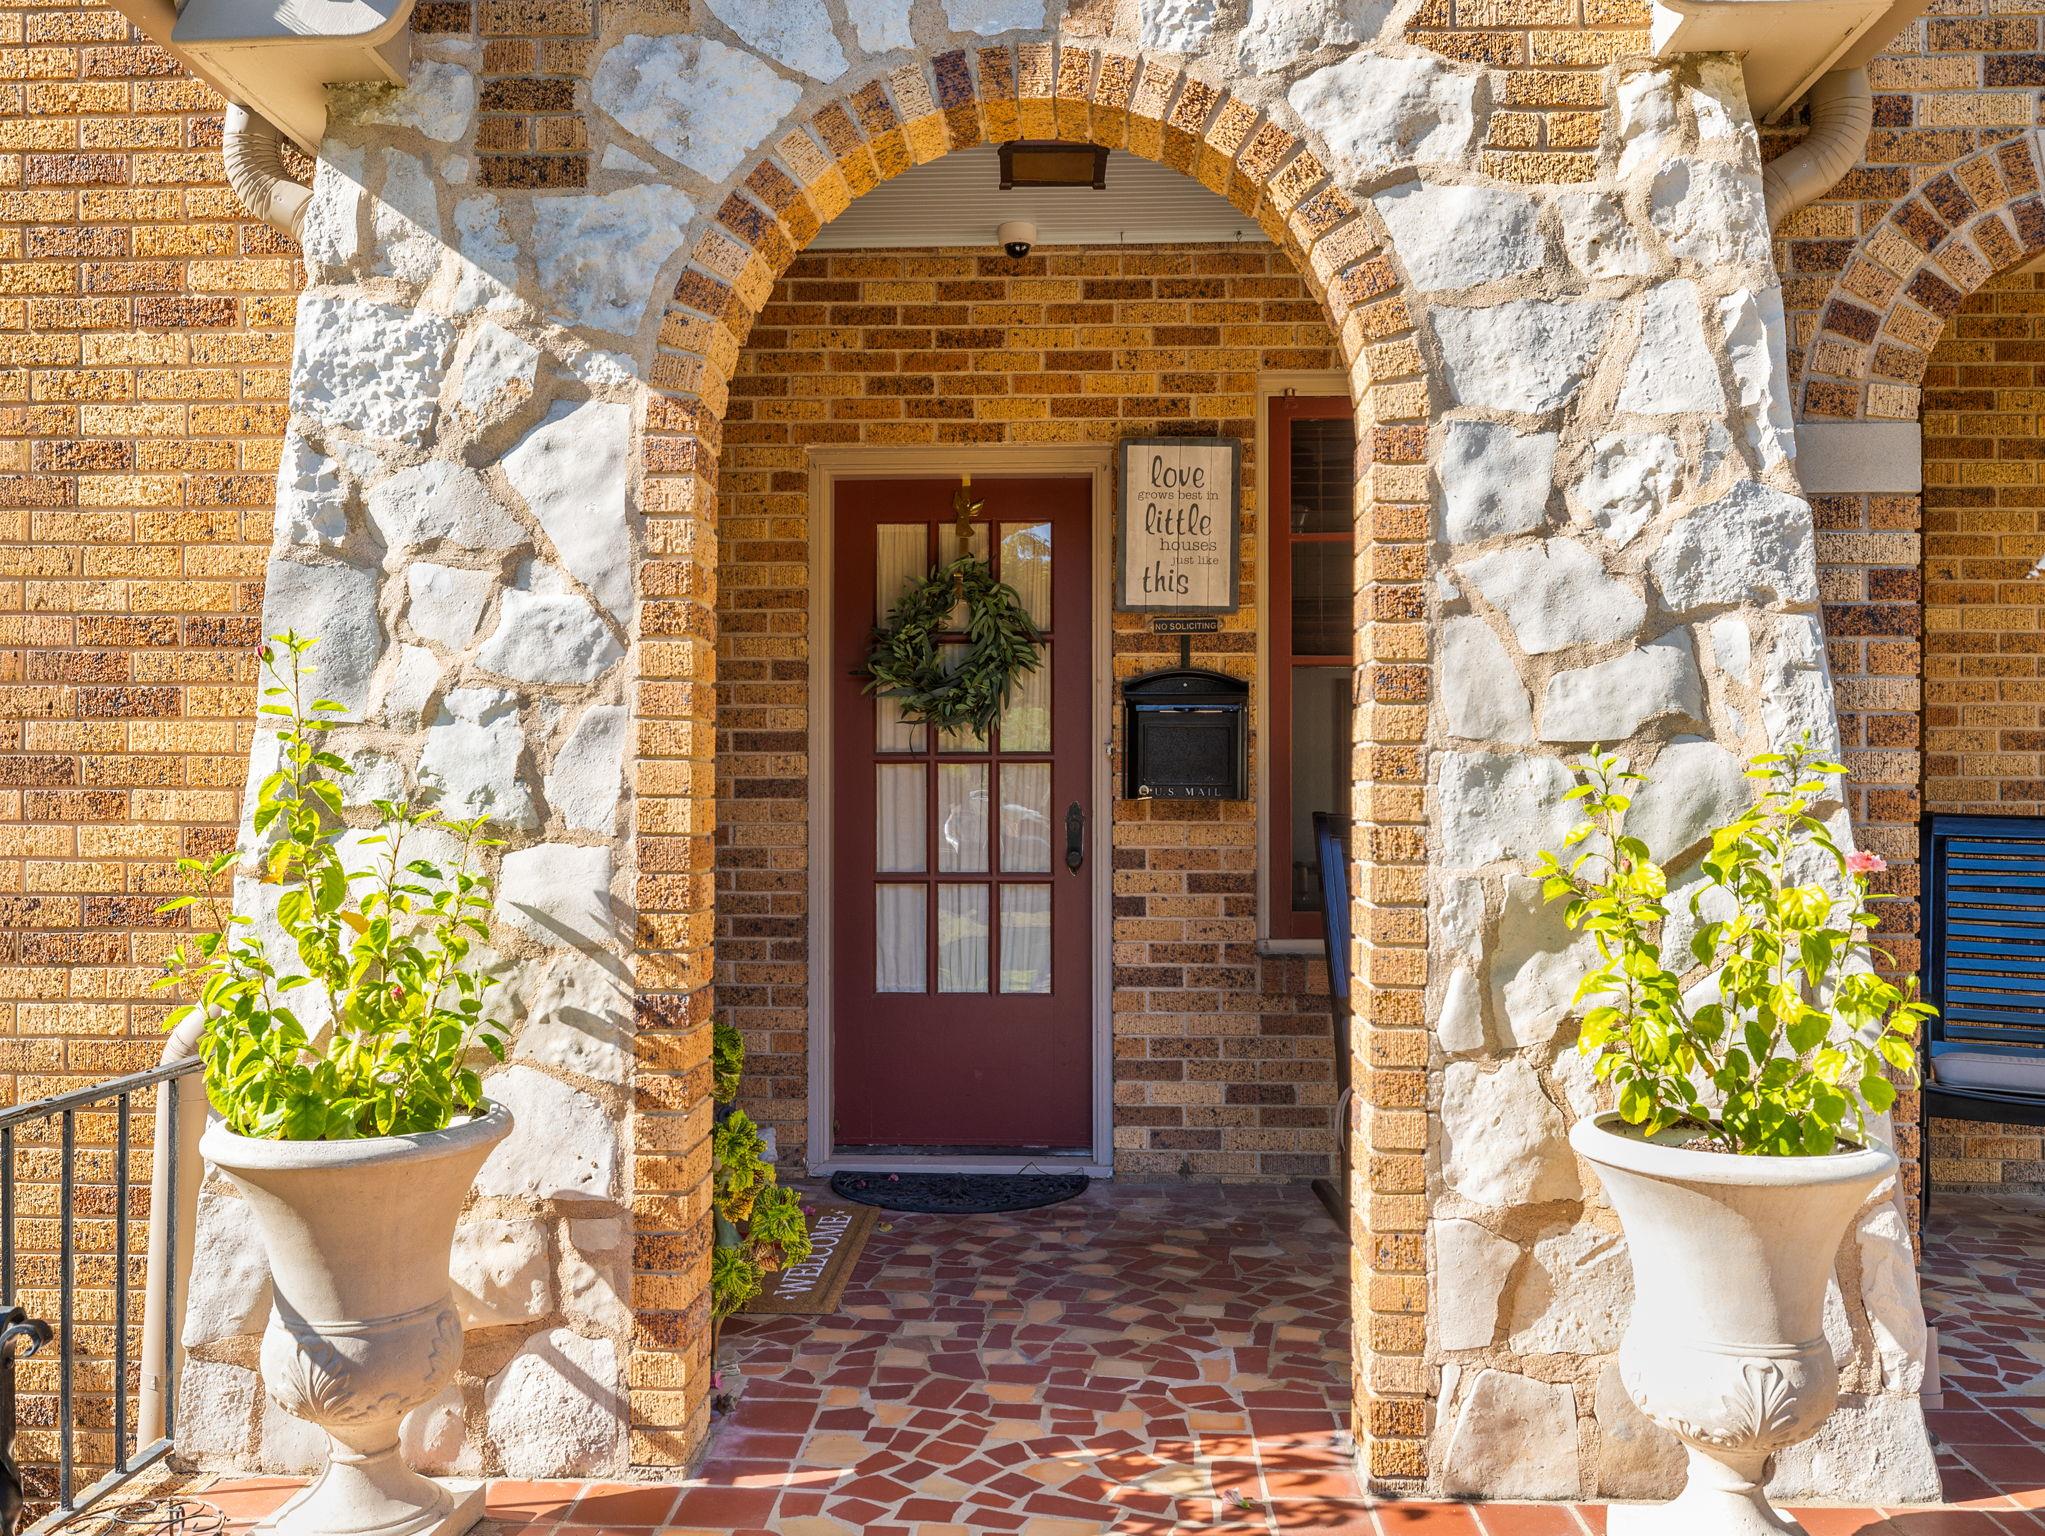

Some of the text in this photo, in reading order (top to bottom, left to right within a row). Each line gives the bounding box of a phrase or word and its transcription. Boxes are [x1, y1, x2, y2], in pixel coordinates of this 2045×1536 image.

[1152, 455, 1205, 488] love
[1138, 490, 1219, 501] grows best in
[1145, 503, 1212, 536] little
[1160, 538, 1217, 551] houses
[1171, 556, 1219, 566] just like
[1143, 560, 1189, 594] this
[1170, 622, 1217, 630] SOLICITING
[1185, 787, 1221, 796] MAIL
[773, 1215, 853, 1295] WELCOME
